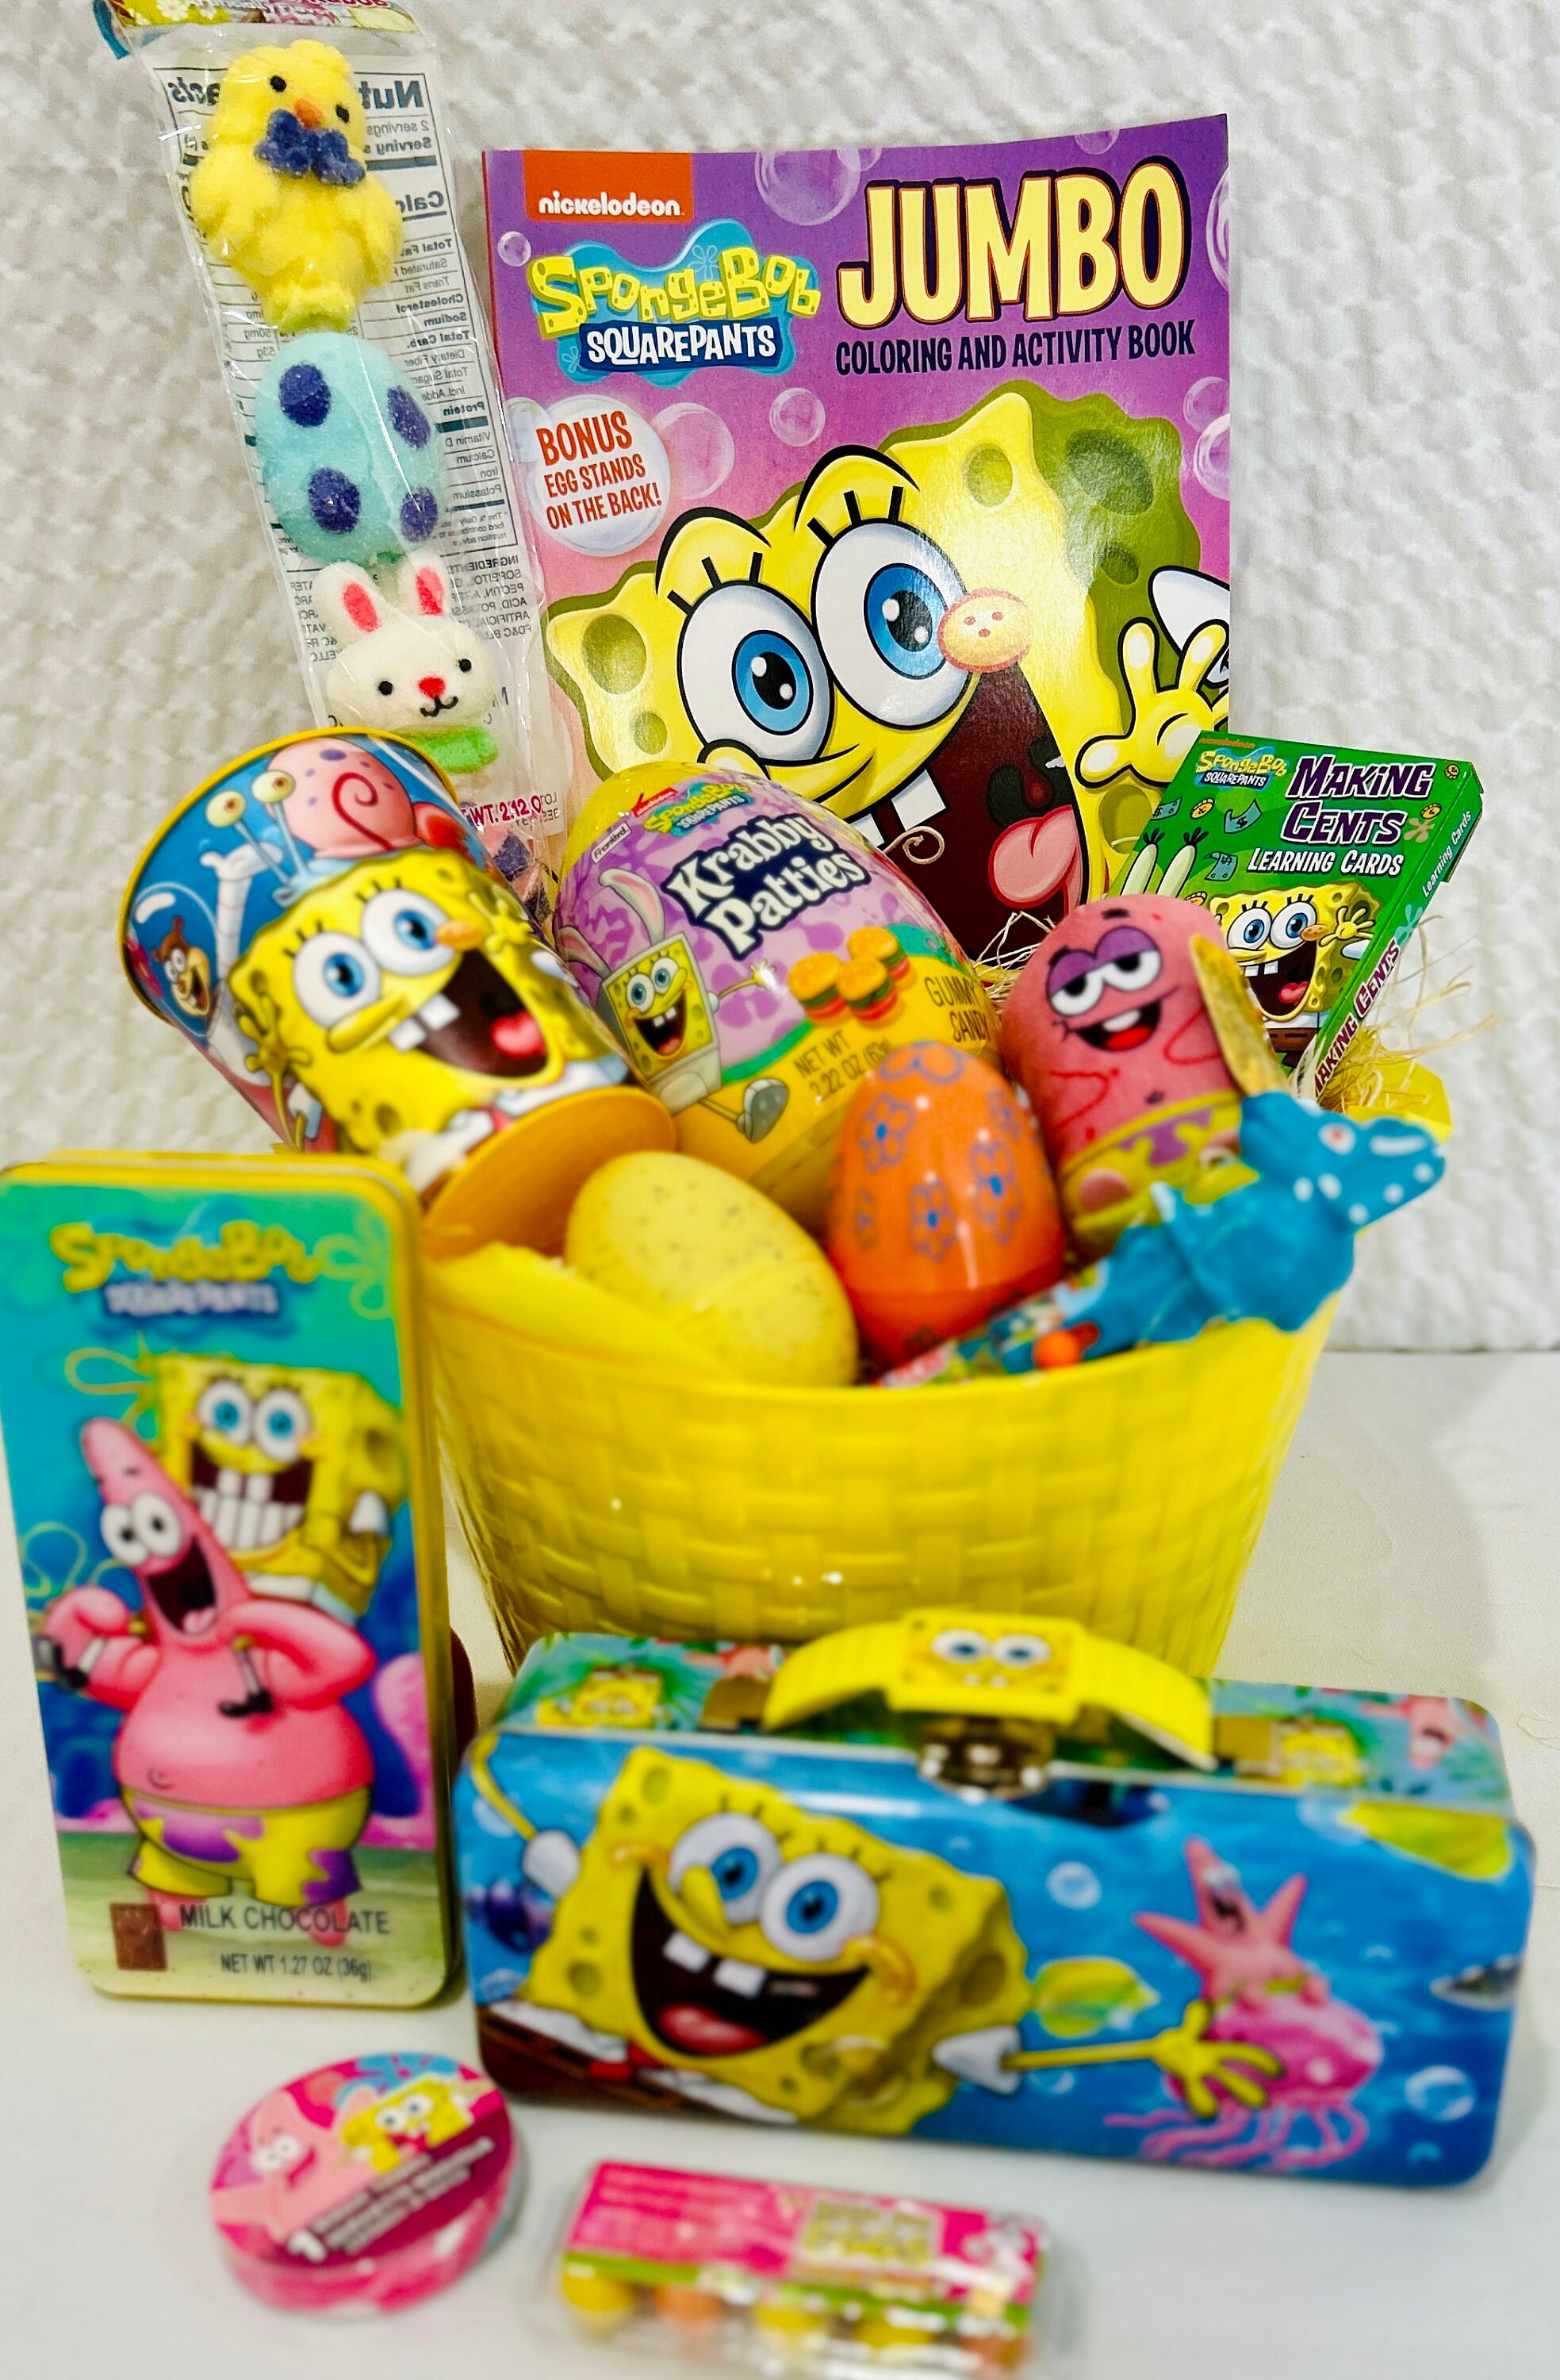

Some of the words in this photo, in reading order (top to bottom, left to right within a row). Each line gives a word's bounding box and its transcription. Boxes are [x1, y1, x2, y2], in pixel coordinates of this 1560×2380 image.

[539, 190, 680, 217] nickelodeon
[837, 157, 1190, 328] JUMBO
[527, 247, 822, 340] SpongeBob
[586, 321, 776, 365] SQUAREPANTS
[836, 337, 952, 375] COLORING
[958, 334, 1007, 370] AND
[1012, 327, 1122, 367] ACTIVITY
[1129, 320, 1195, 359] BOOK
[536, 411, 632, 466] BONUS
[544, 469, 578, 497] EGG
[579, 454, 646, 490] STANDS
[546, 503, 573, 530] ON
[572, 495, 608, 524] THE
[607, 482, 662, 516] BACK!
[1195, 750, 1287, 777] SpongeBob
[1204, 771, 1267, 787] SQUAREPANTS
[665, 816, 834, 919] Krabby
[1248, 848, 1336, 873] LEARNING
[1340, 850, 1404, 876] CARDS
[1423, 845, 1453, 897] Learning
[1451, 810, 1471, 845] Cards
[704, 854, 865, 954] Patties
[924, 976, 980, 1008] GUMMY
[949, 1010, 991, 1043] CANDY
[793, 1046, 826, 1079] NET
[822, 1030, 850, 1058] WT
[841, 1054, 865, 1081] OZ
[180, 1904, 237, 1929] MILK
[243, 1905, 390, 1934] CHOCOLATE
[220, 1952, 249, 1973] NET
[252, 1954, 276, 1975] WT
[280, 1955, 307, 1975] 1.27
[313, 1956, 334, 1977] OZ
[337, 1956, 373, 1982] (36g)
